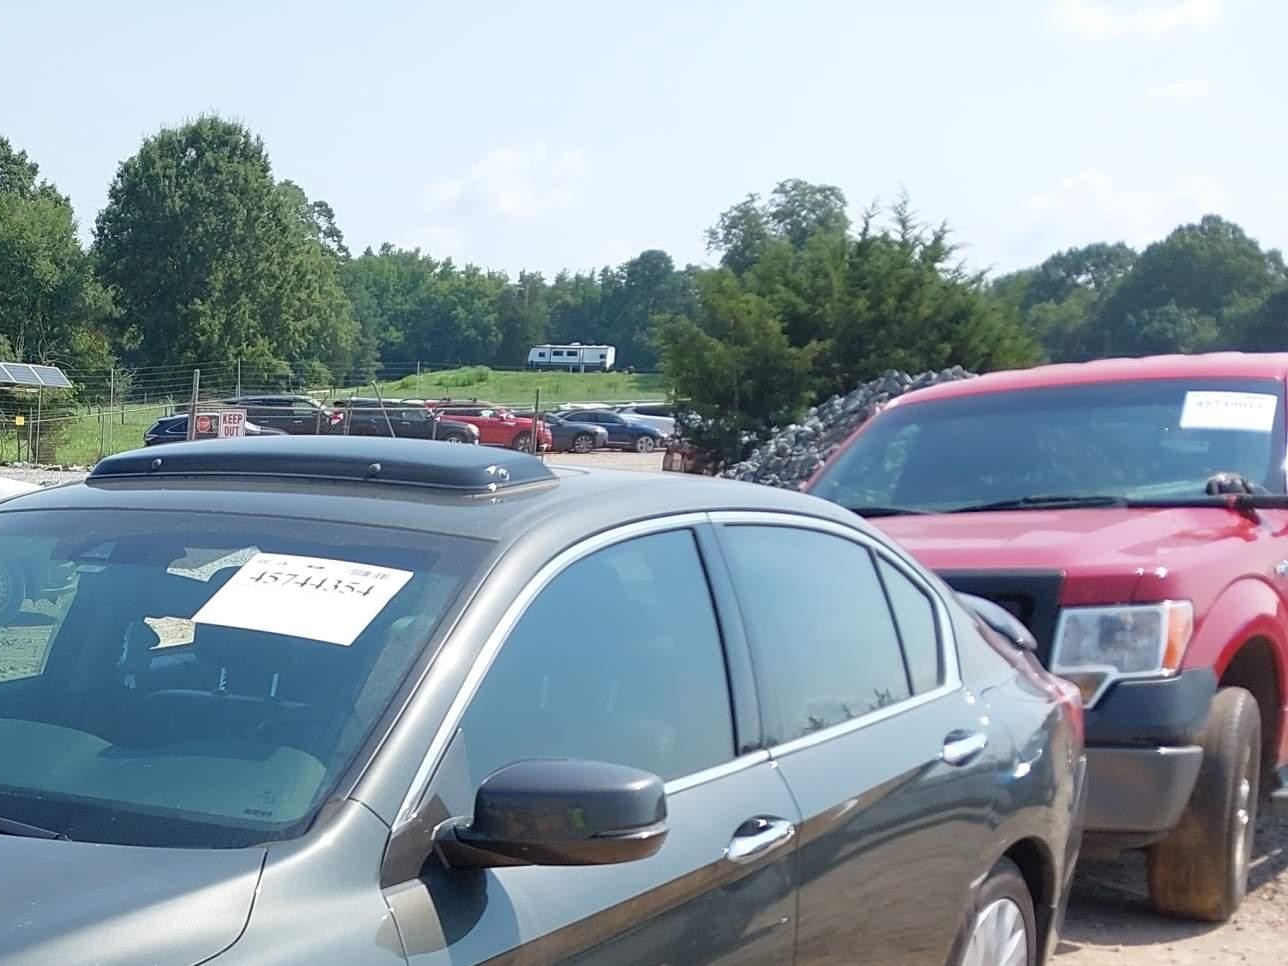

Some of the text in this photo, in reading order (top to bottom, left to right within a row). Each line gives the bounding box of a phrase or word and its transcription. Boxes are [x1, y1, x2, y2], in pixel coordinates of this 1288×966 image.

[222, 413, 243, 424] KEEP
[224, 426, 239, 437] OUT
[250, 570, 375, 597] 45744354
